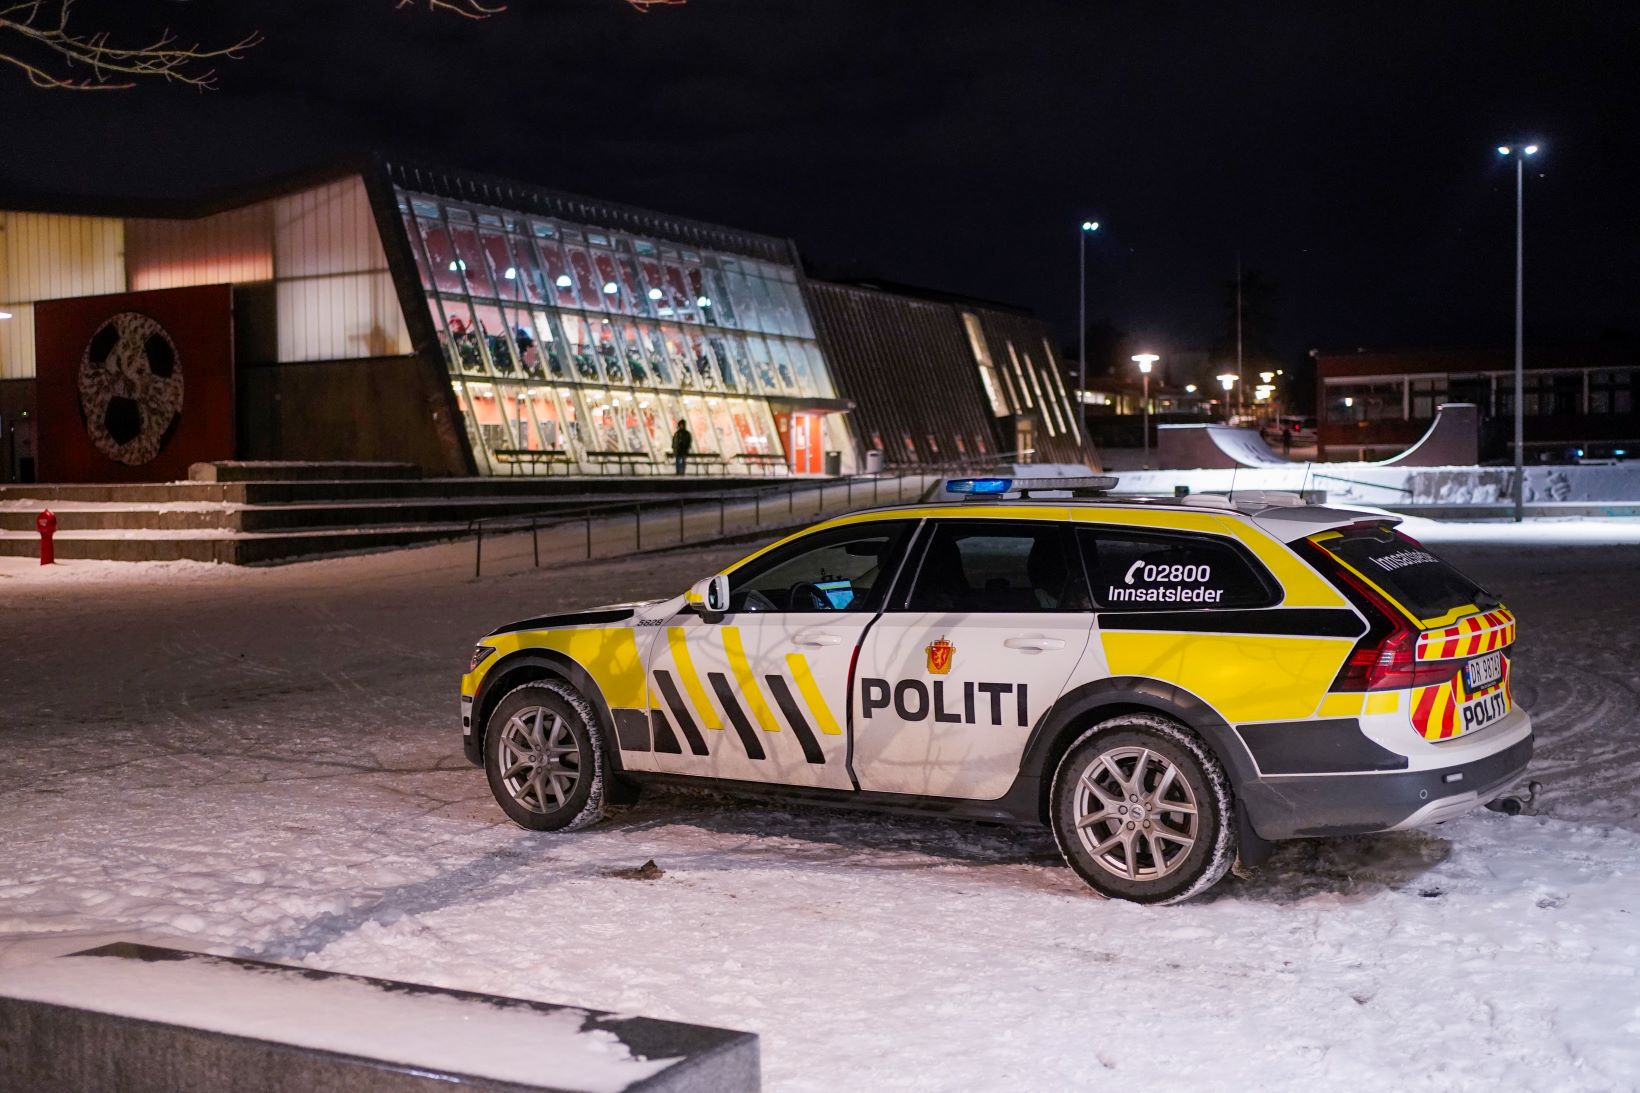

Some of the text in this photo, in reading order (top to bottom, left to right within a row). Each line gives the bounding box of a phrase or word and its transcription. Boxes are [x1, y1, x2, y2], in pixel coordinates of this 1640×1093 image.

[1143, 564, 1211, 583] 02800
[1108, 585, 1224, 602] Innsatsleder
[1471, 662, 1481, 684] DR
[861, 677, 1029, 727] POLITI
[1463, 691, 1506, 731] POLITI
